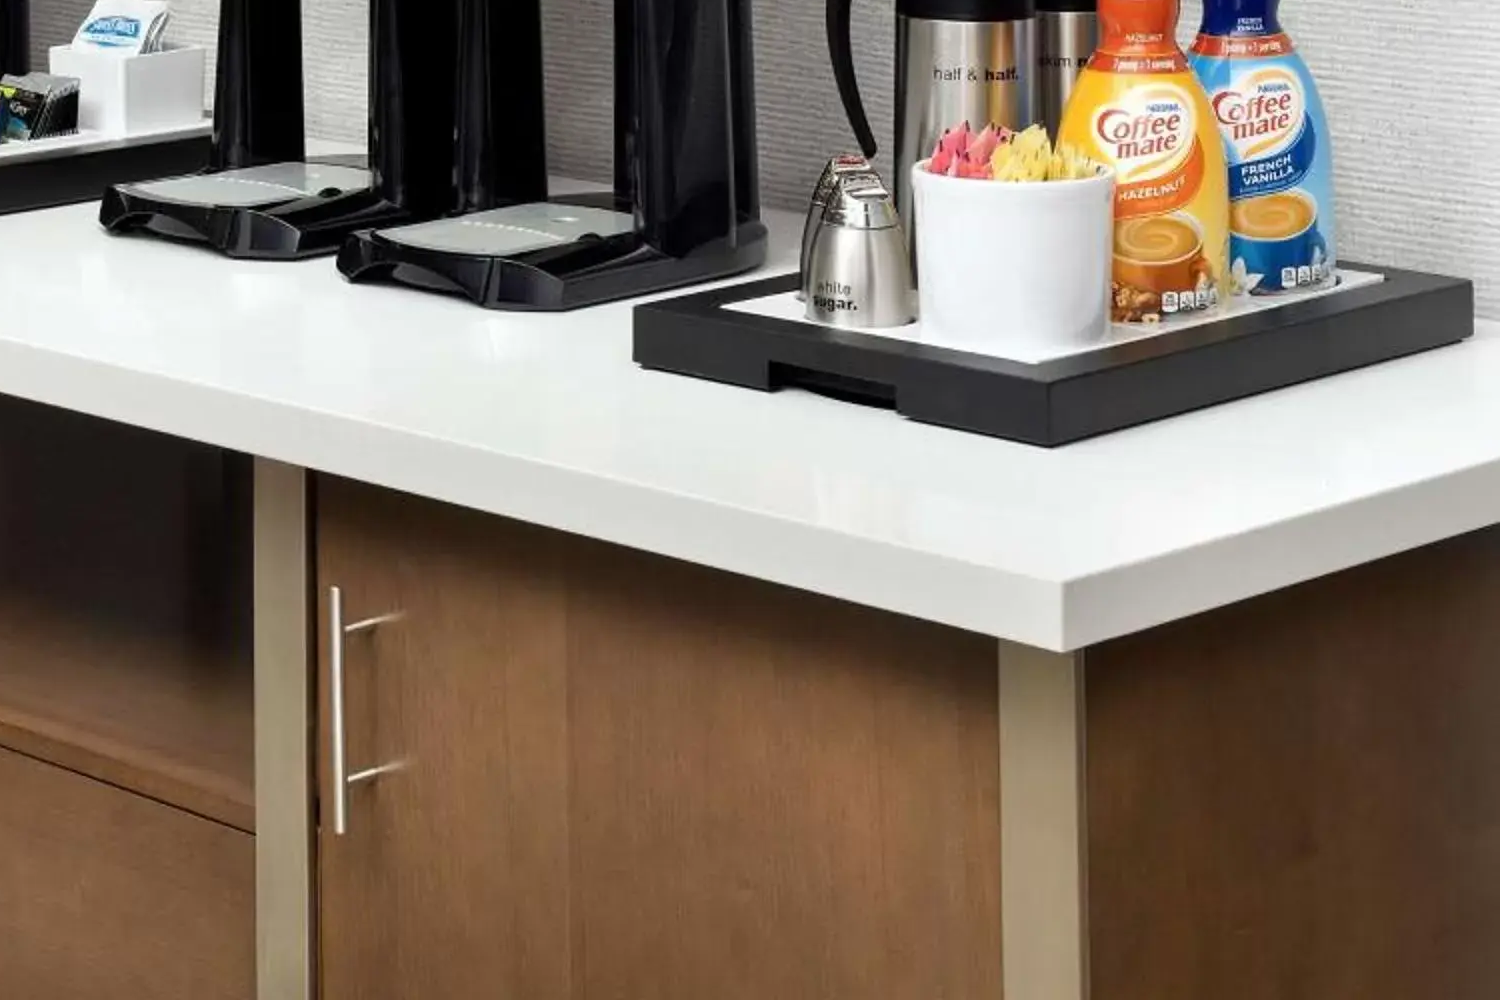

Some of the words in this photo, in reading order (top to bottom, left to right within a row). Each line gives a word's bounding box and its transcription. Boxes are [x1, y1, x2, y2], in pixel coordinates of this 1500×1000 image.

[933, 66, 961, 81] half
[1212, 91, 1291, 125] Coffee
[1097, 108, 1181, 144] Coffee
[1232, 112, 1290, 141] mate
[1116, 133, 1178, 159] mate
[1241, 154, 1292, 177] FRENCH
[1243, 165, 1295, 186] VANILLA
[1119, 175, 1187, 201] HAZELNUT
